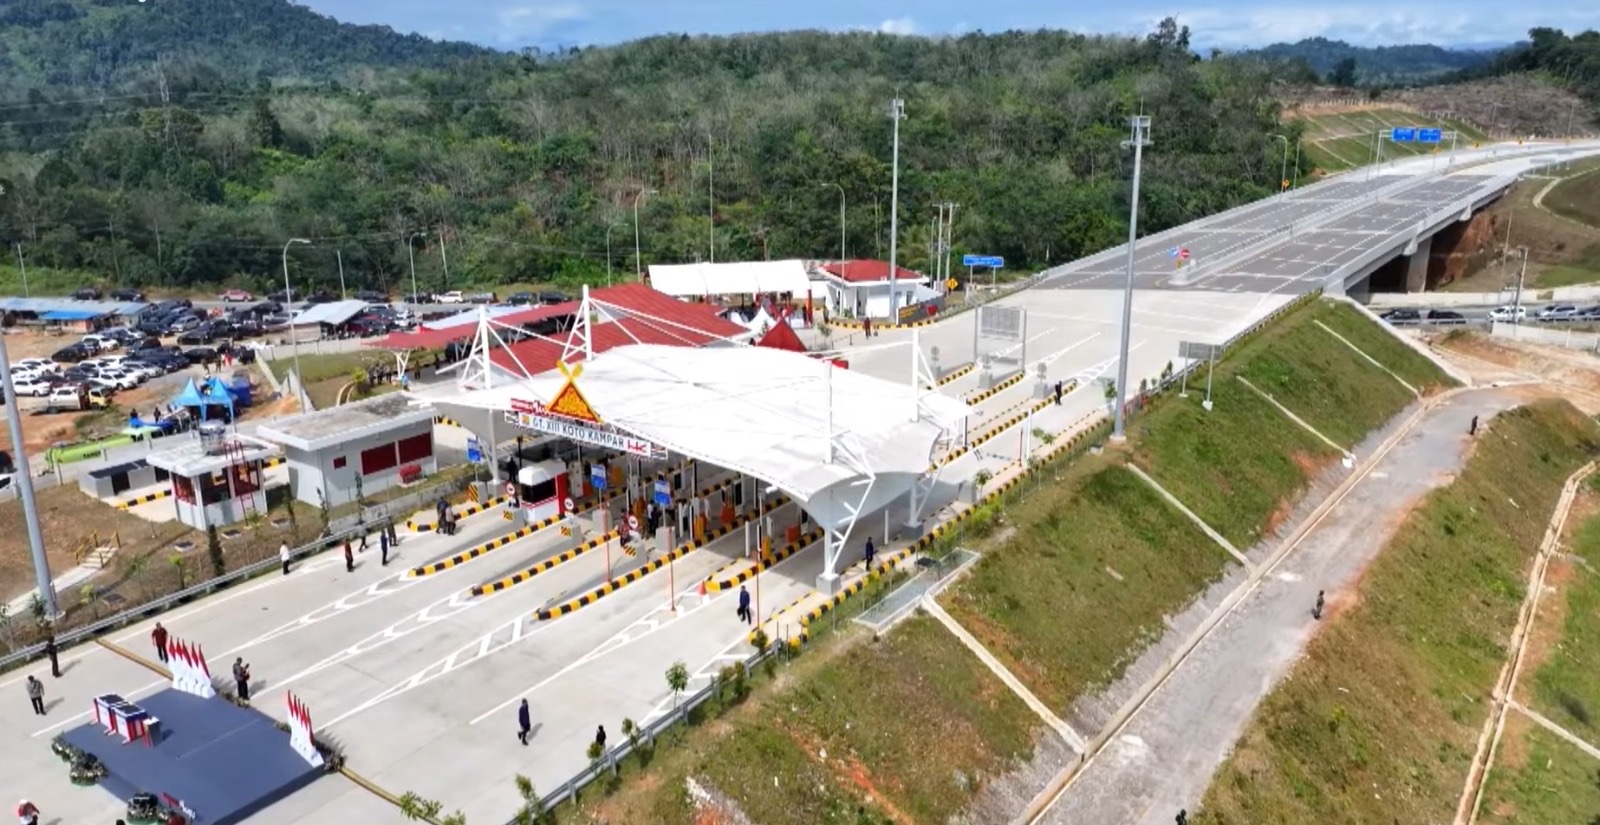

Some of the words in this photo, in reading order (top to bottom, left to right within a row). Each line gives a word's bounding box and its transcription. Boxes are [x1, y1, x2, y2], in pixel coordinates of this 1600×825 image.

[546, 420, 560, 432] XIII
[562, 424, 585, 439] KOTO
[588, 430, 624, 447] KAMPAR
